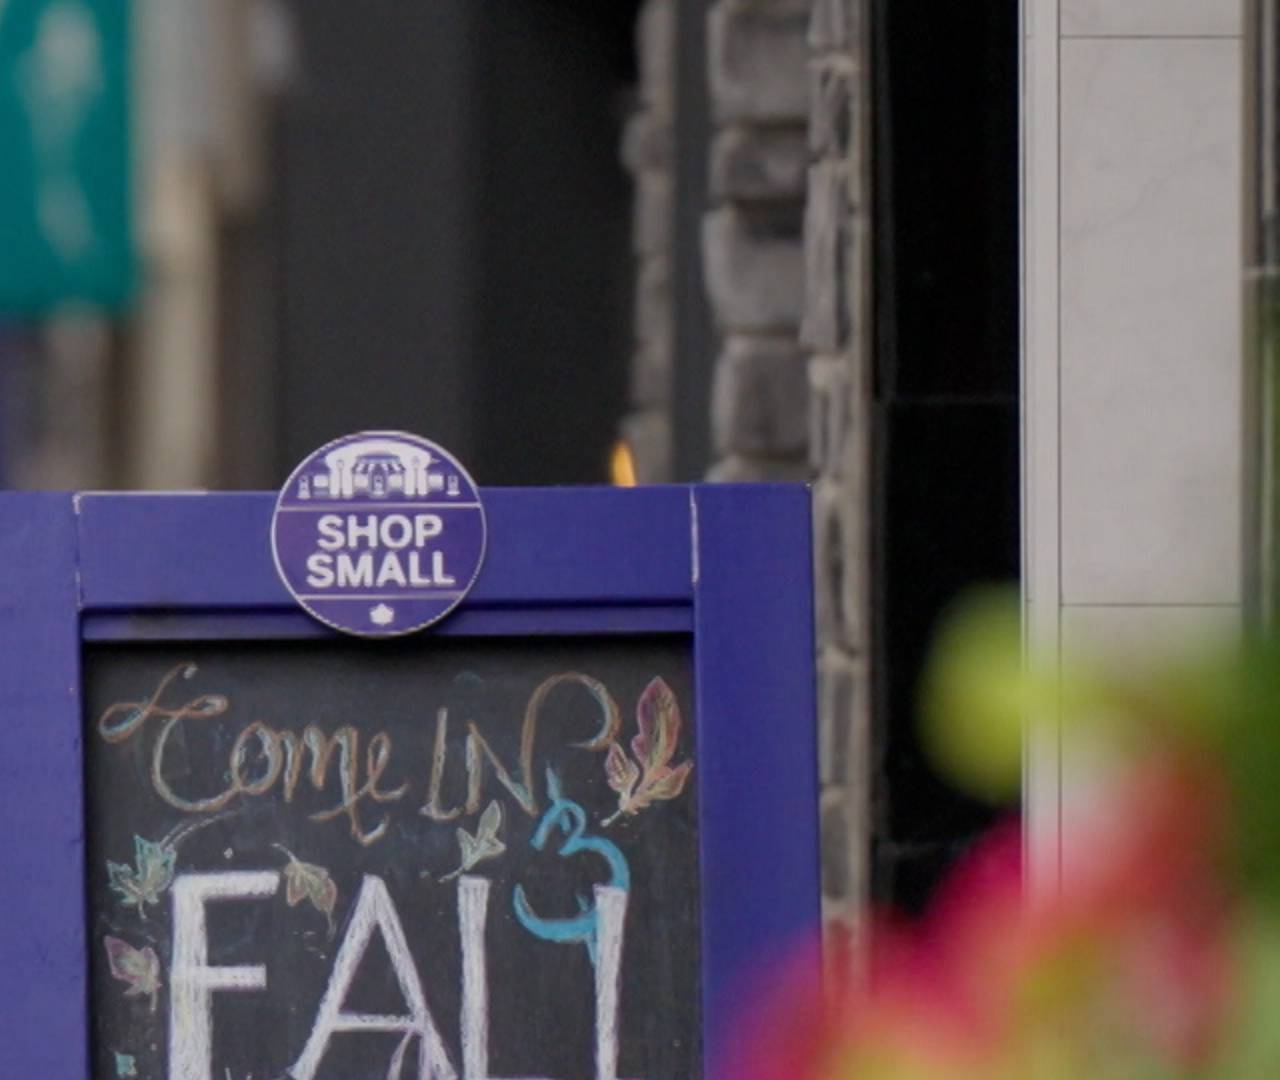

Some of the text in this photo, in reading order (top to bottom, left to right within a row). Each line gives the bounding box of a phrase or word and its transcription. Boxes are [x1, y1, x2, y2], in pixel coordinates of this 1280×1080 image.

[316, 513, 443, 551] SHOP
[305, 550, 456, 589] SMALL
[98, 663, 622, 847] Come IN
